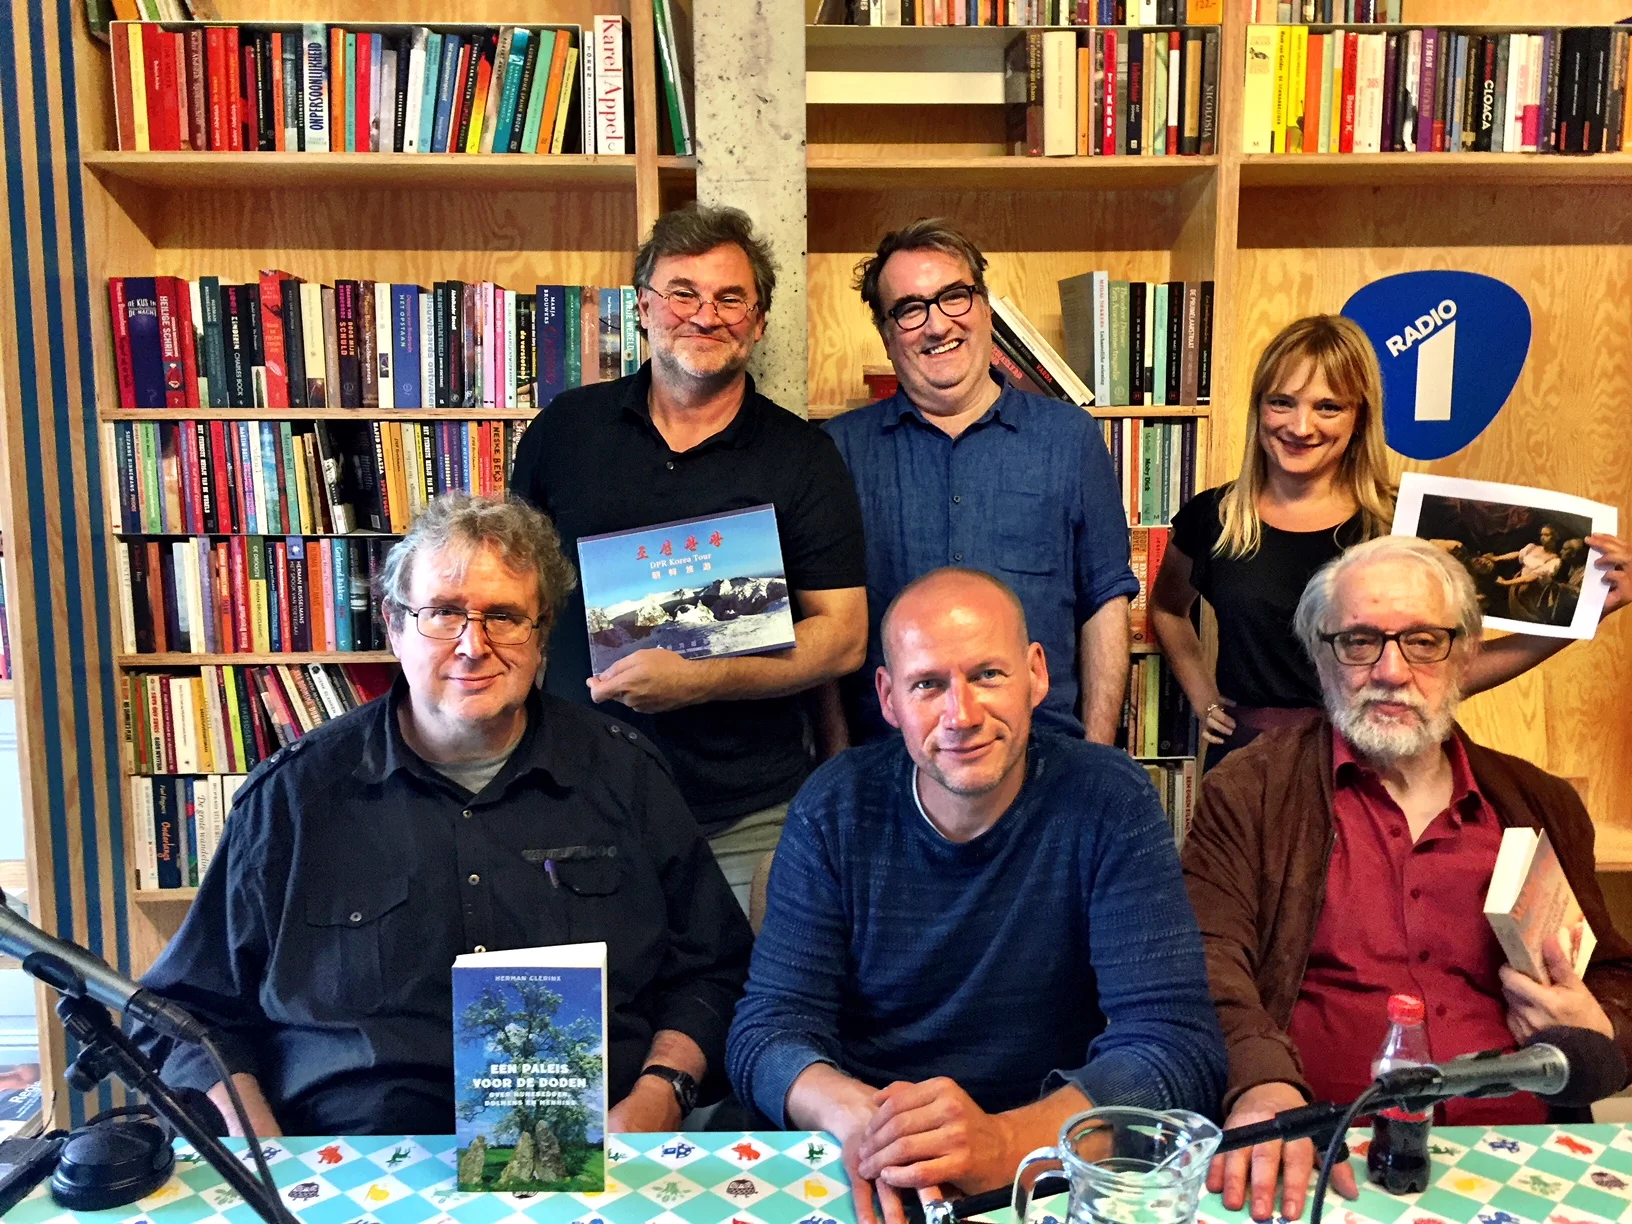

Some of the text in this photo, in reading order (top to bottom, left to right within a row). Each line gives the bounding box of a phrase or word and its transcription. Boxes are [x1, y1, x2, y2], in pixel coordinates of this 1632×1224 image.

[471, 44, 479, 64] THOMAS
[308, 42, 324, 130] ONPERSOONLIJKHEID
[466, 78, 474, 99] AALTEN
[599, 20, 624, 140] Karel Appel
[1030, 82, 1038, 101] chaos
[1202, 85, 1214, 138] NICOLOSIA
[1346, 95, 1354, 123] Dossier
[1482, 80, 1494, 130] CLOACA
[137, 299, 148, 307] KUS
[626, 300, 635, 320] VRIJE
[1120, 287, 1128, 318] Theodore
[160, 296, 174, 358] HEILIGE SCHRIK
[340, 322, 348, 356] SCHULD
[426, 294, 434, 358] Blauwbaards
[626, 322, 634, 350] WERELD
[1386, 299, 1458, 358] RADIO
[234, 352, 242, 378] CHARLES
[1036, 364, 1053, 384] VANDA
[1415, 320, 1456, 422] 1
[236, 379, 244, 396] BOCK
[376, 444, 384, 475] BOUAZZA
[493, 427, 502, 482] NESKE BEKS
[335, 547, 344, 576] Gerbrand
[650, 554, 712, 570] DPR Korea Tour
[1140, 563, 1146, 578] DE
[158, 822, 176, 861] Onderlangs
[196, 795, 210, 874] De grote wandeling
[473, 1078, 586, 1088] VOOR DE DODEN
[491, 1064, 570, 1074] EEN PALEIS
